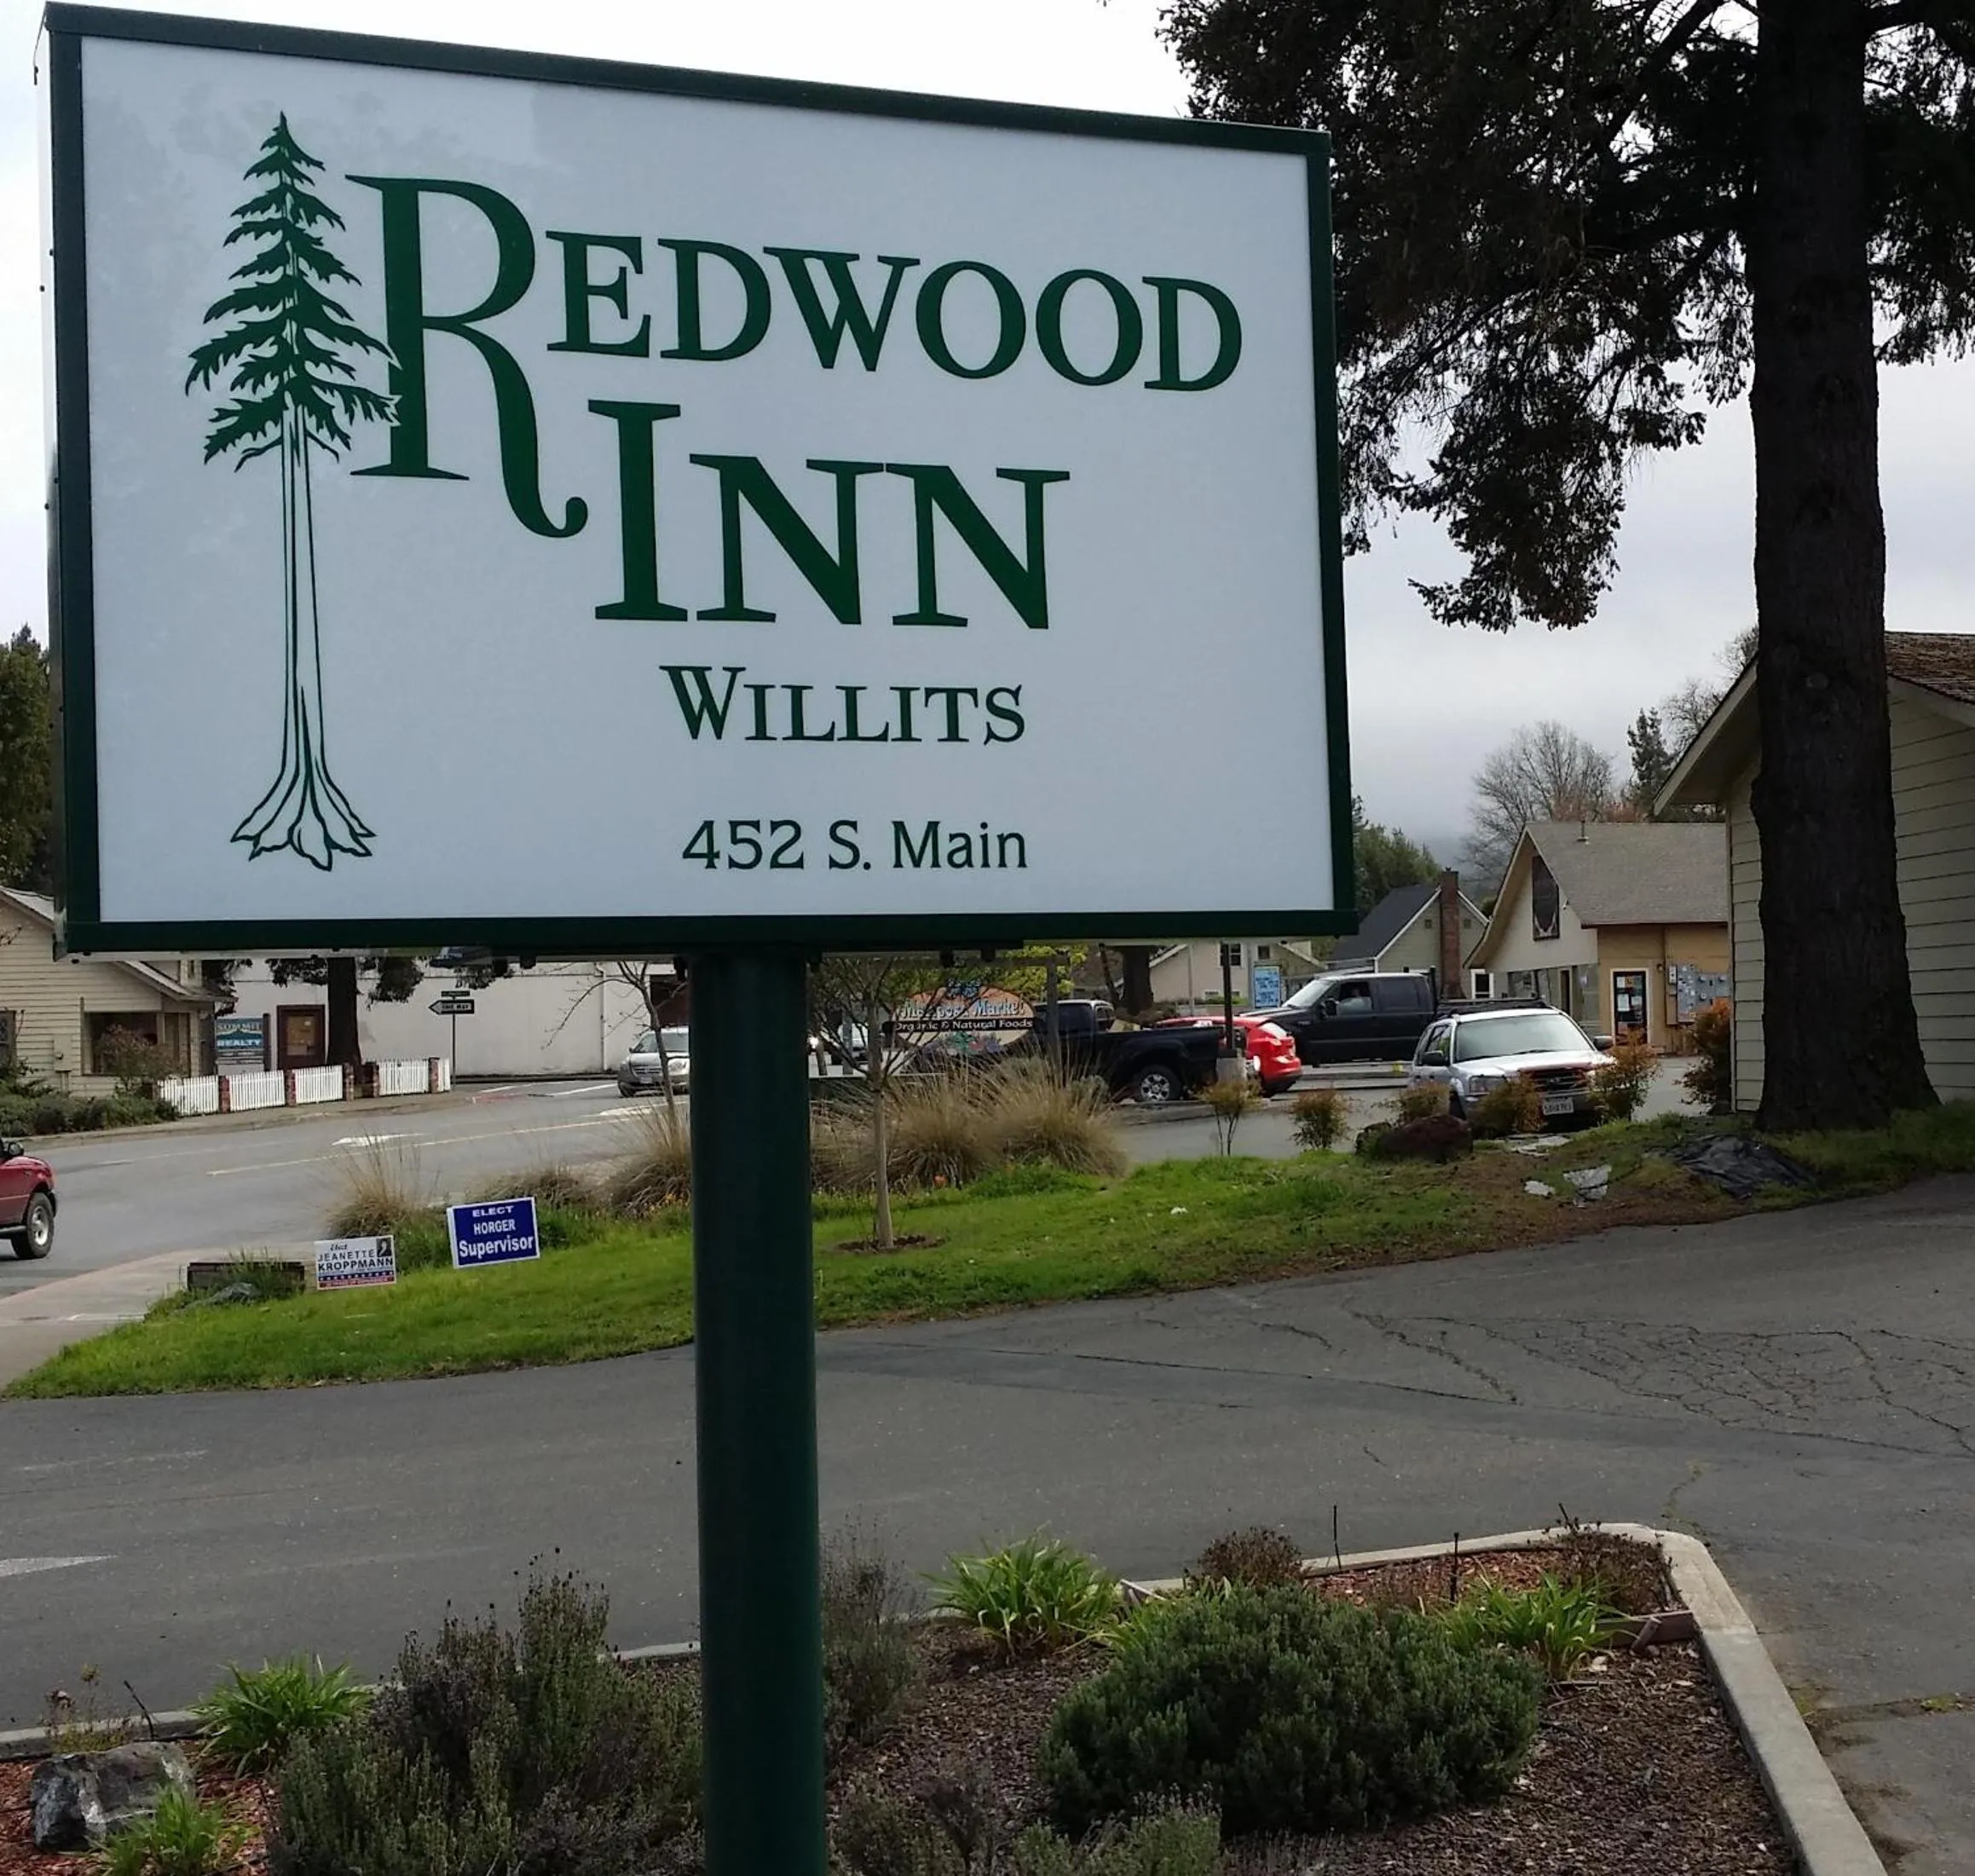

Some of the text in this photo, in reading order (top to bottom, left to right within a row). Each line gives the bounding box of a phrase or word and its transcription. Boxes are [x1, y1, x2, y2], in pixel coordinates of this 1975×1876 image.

[344, 175, 1242, 539] REDWOOD
[587, 399, 1071, 630] INN
[659, 666, 1025, 746] WILLITS
[682, 819, 1027, 870] 452 S. Main
[973, 996, 1026, 1017] Market
[953, 1019, 996, 1030] Natural
[999, 1019, 1033, 1028] Foods
[217, 1039, 261, 1048] REALTY
[472, 1205, 514, 1218] ELECT
[473, 1219, 517, 1235] HORGER
[317, 1249, 375, 1261] JEANETTE
[459, 1234, 534, 1259] Supervisor
[318, 1257, 393, 1272] KROPPMANN
